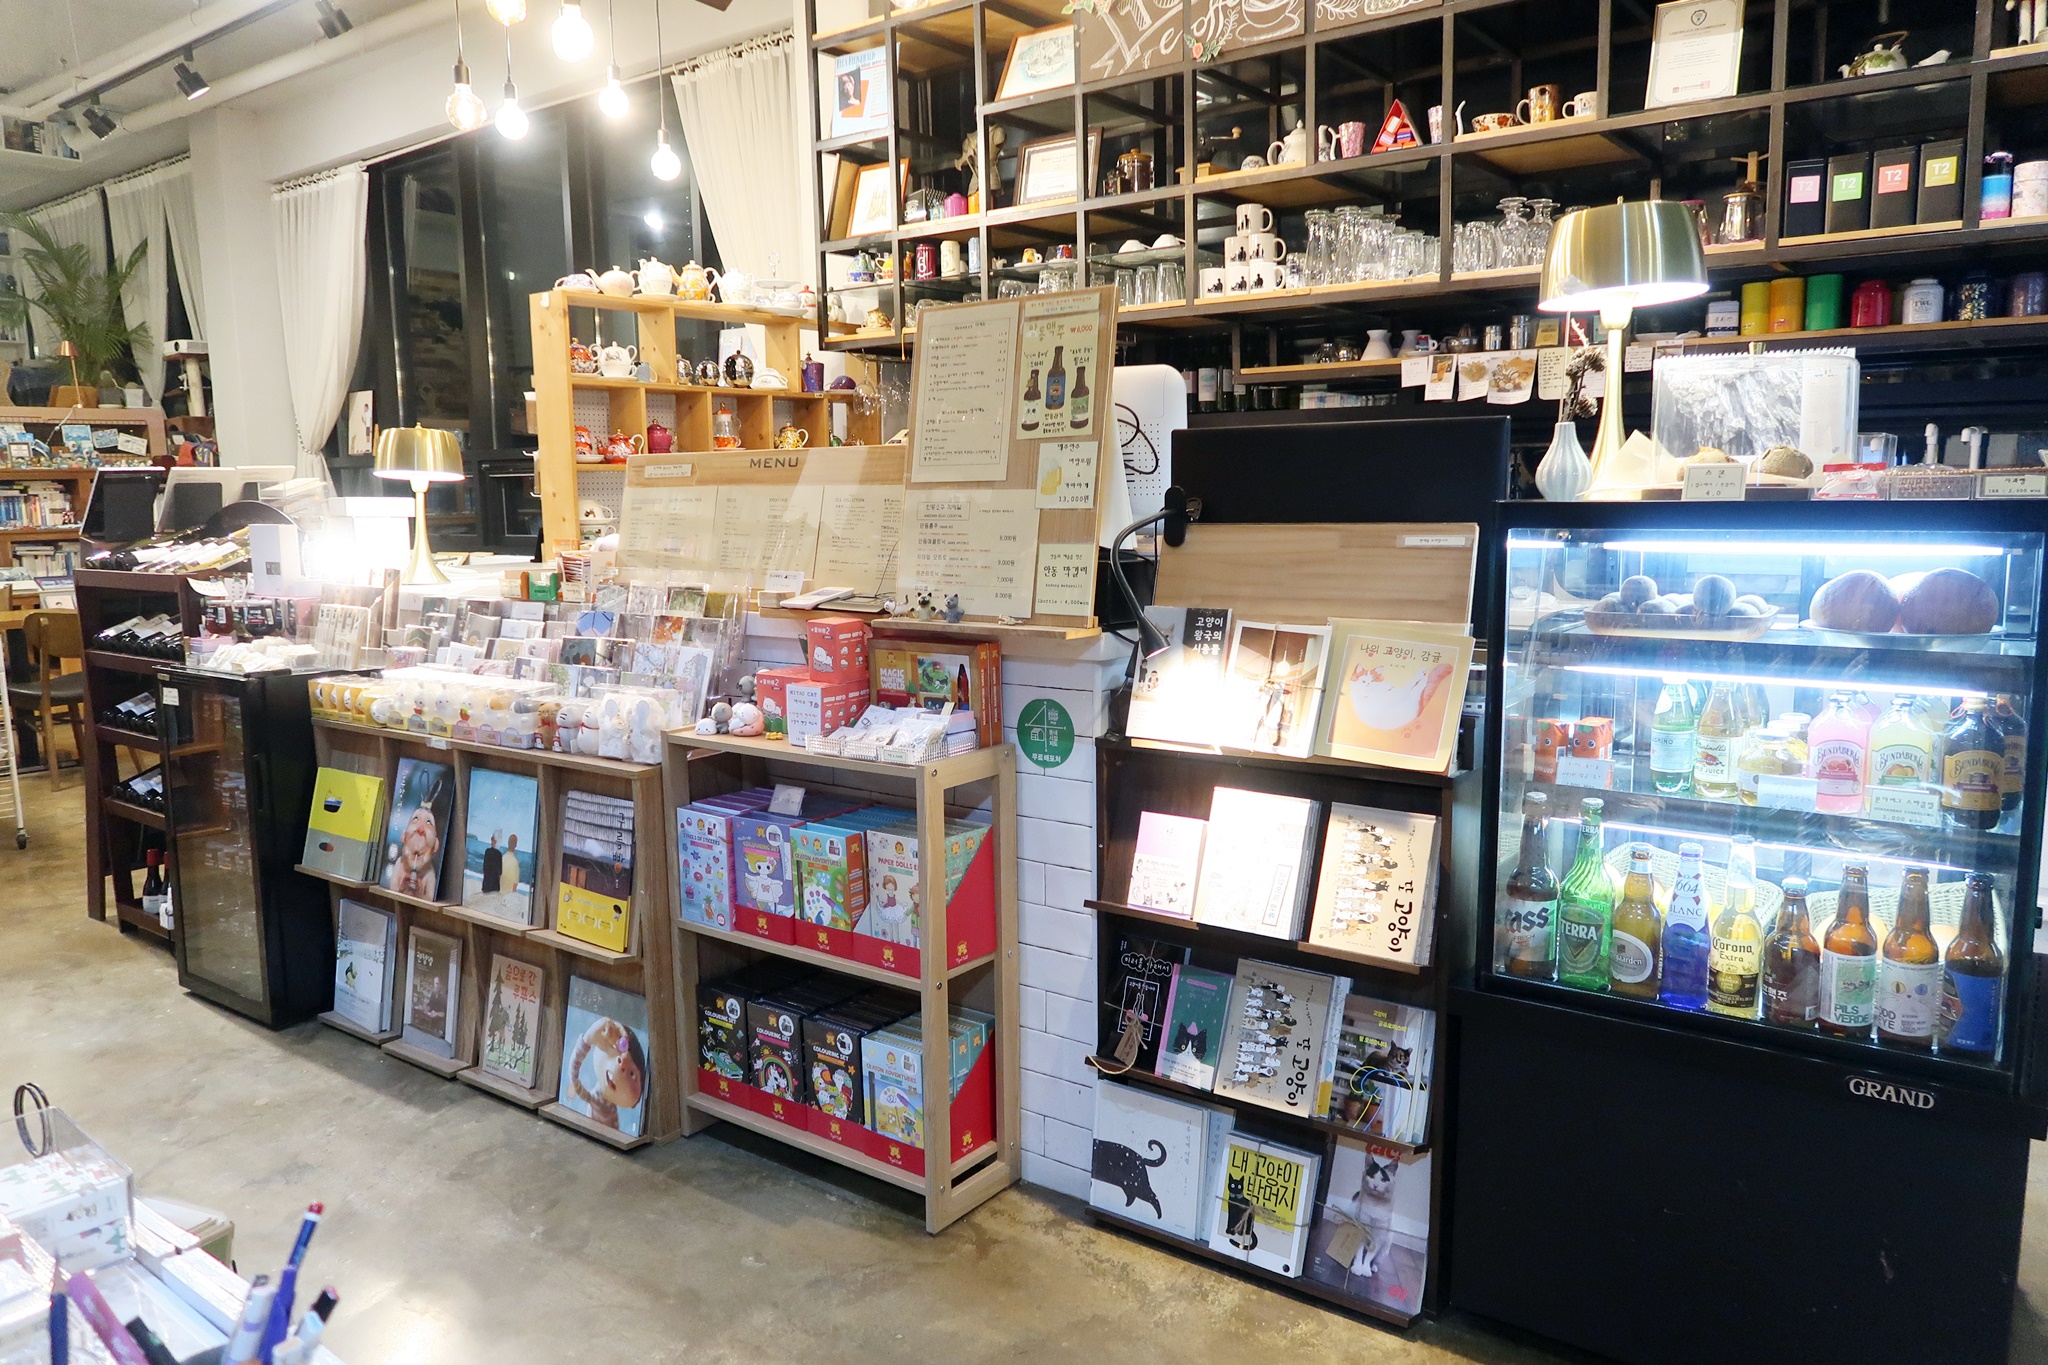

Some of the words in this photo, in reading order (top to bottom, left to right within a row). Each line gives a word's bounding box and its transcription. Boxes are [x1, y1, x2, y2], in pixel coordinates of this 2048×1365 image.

[1885, 169, 1902, 182] T2
[1932, 162, 1950, 175] T2
[1797, 180, 1813, 192] T2
[1840, 178, 1856, 189] T2
[749, 456, 799, 469] MENU
[1058, 495, 1089, 503] 13,000원
[1043, 565, 1058, 578] 안동
[1063, 565, 1088, 578] 막걸리
[1195, 616, 1224, 628] 고양이
[1193, 629, 1222, 642] 왕국의
[1360, 643, 1380, 654] 나의
[1383, 646, 1416, 661] 고양이,
[1420, 650, 1442, 663] 감귤
[879, 668, 905, 678] MAGIC
[881, 682, 906, 690] WORLD
[1813, 744, 1862, 768] BUNDABERG
[1875, 748, 1923, 772] BUNDABERG
[1704, 767, 1725, 775] JUICE
[811, 854, 842, 867] ADVENTURES
[877, 856, 894, 867] PAPER
[895, 859, 913, 870] DOLLS
[1398, 880, 1414, 894] 또
[1388, 898, 1413, 952] 고양이
[1560, 920, 1598, 941] TERRA
[1712, 936, 1755, 955] Corona
[1124, 956, 1143, 969] 미러볼
[1719, 950, 1744, 963] Extra
[505, 963, 527, 982] 숲으로
[527, 970, 537, 987] 간
[512, 984, 537, 1004] 루푸스
[1834, 1004, 1859, 1015] PILS
[704, 1009, 727, 1021] COLOURING
[727, 1016, 737, 1025] SET
[1834, 1013, 1869, 1024] VERDE
[756, 1027, 782, 1040] COLOURING
[781, 1035, 791, 1043] SET
[1296, 1037, 1311, 1051] 또
[813, 1045, 840, 1059] COLOURING
[840, 1053, 850, 1062] SET
[885, 1067, 917, 1085] ADVENTURES
[1285, 1054, 1310, 1107] 고양이
[1849, 1078, 1935, 1109] GRAND
[1231, 1150, 1249, 1174] 내
[1252, 1153, 1300, 1187] 고양이
